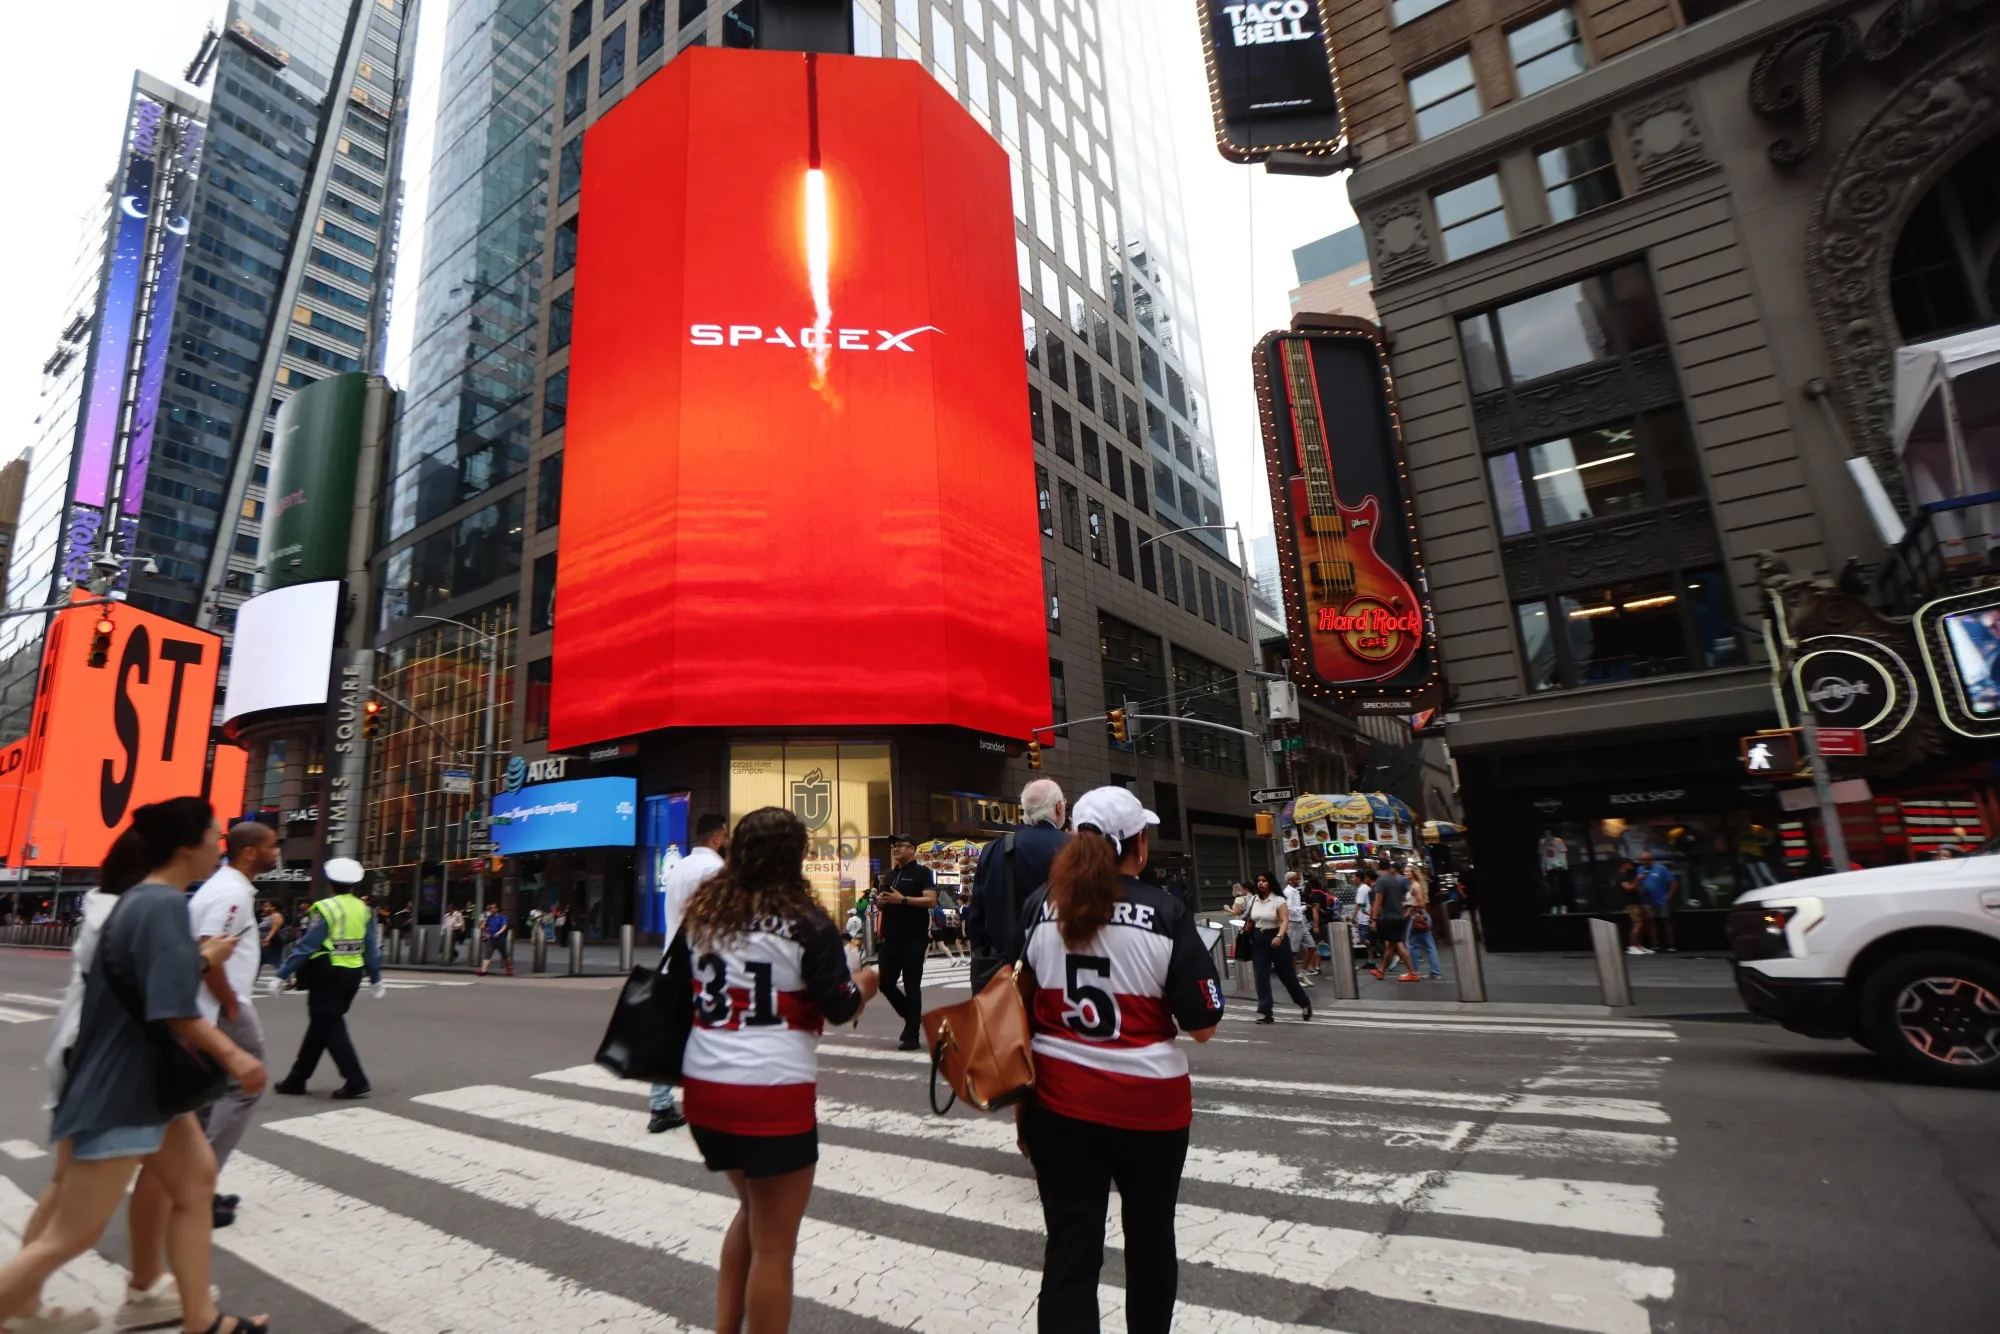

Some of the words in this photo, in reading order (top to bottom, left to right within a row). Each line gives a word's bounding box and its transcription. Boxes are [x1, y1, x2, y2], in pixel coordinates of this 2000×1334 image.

[1223, 0, 1309, 27] TACO
[1233, 20, 1315, 47] BELL
[690, 324, 947, 352] SPACEX
[1318, 607, 1370, 632] Hard
[1370, 607, 1422, 636] Rock
[1359, 636, 1389, 648] CAFE
[335, 666, 360, 753] SQUARE
[1362, 701, 1412, 709] SPECTACOLOR
[100, 624, 204, 829] ST
[526, 757, 569, 783] AT&T
[732, 767, 764, 775] campus
[326, 776, 349, 845] TIMES
[805, 863, 851, 873] ERSITY
[1040, 900, 1155, 931] MRE
[693, 952, 789, 1029] 31
[1061, 953, 1122, 1042] 5
